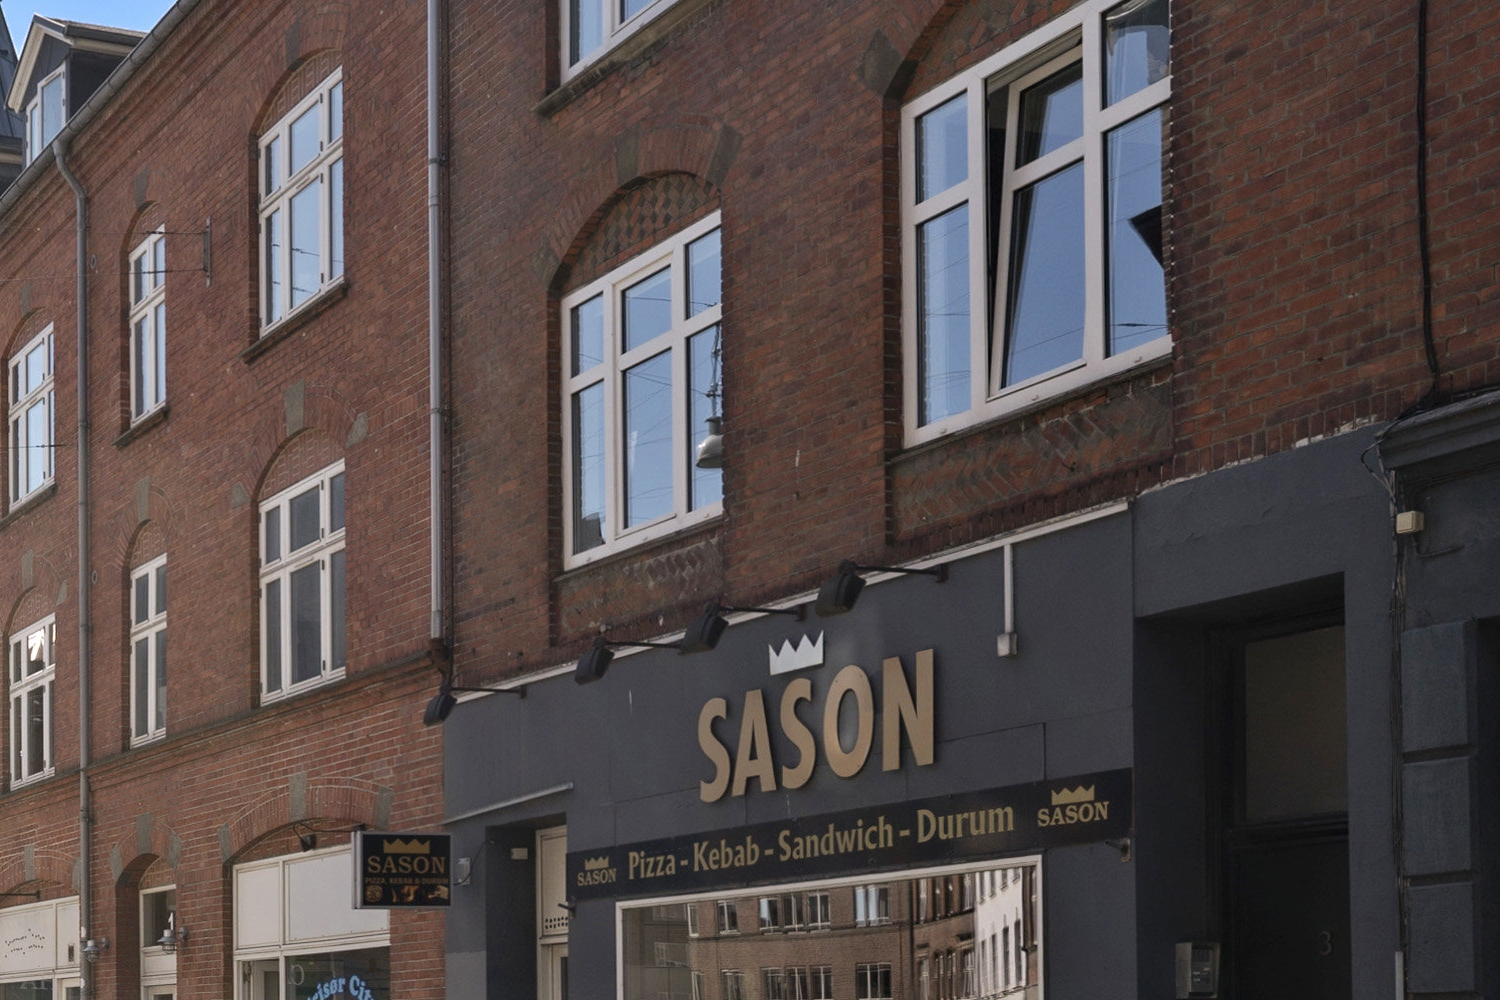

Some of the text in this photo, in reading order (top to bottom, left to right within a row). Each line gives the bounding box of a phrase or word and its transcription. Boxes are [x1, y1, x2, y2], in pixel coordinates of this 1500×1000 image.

[697, 648, 934, 803] SASON
[1037, 801, 1109, 827] SASON
[628, 850, 676, 881] Pizza
[693, 839, 760, 872] Kebab
[778, 815, 894, 863] Sandwich
[916, 803, 1015, 843] Durum
[367, 855, 446, 874] SASON
[577, 867, 617, 886] SASON
[1318, 930, 1333, 957] 3
